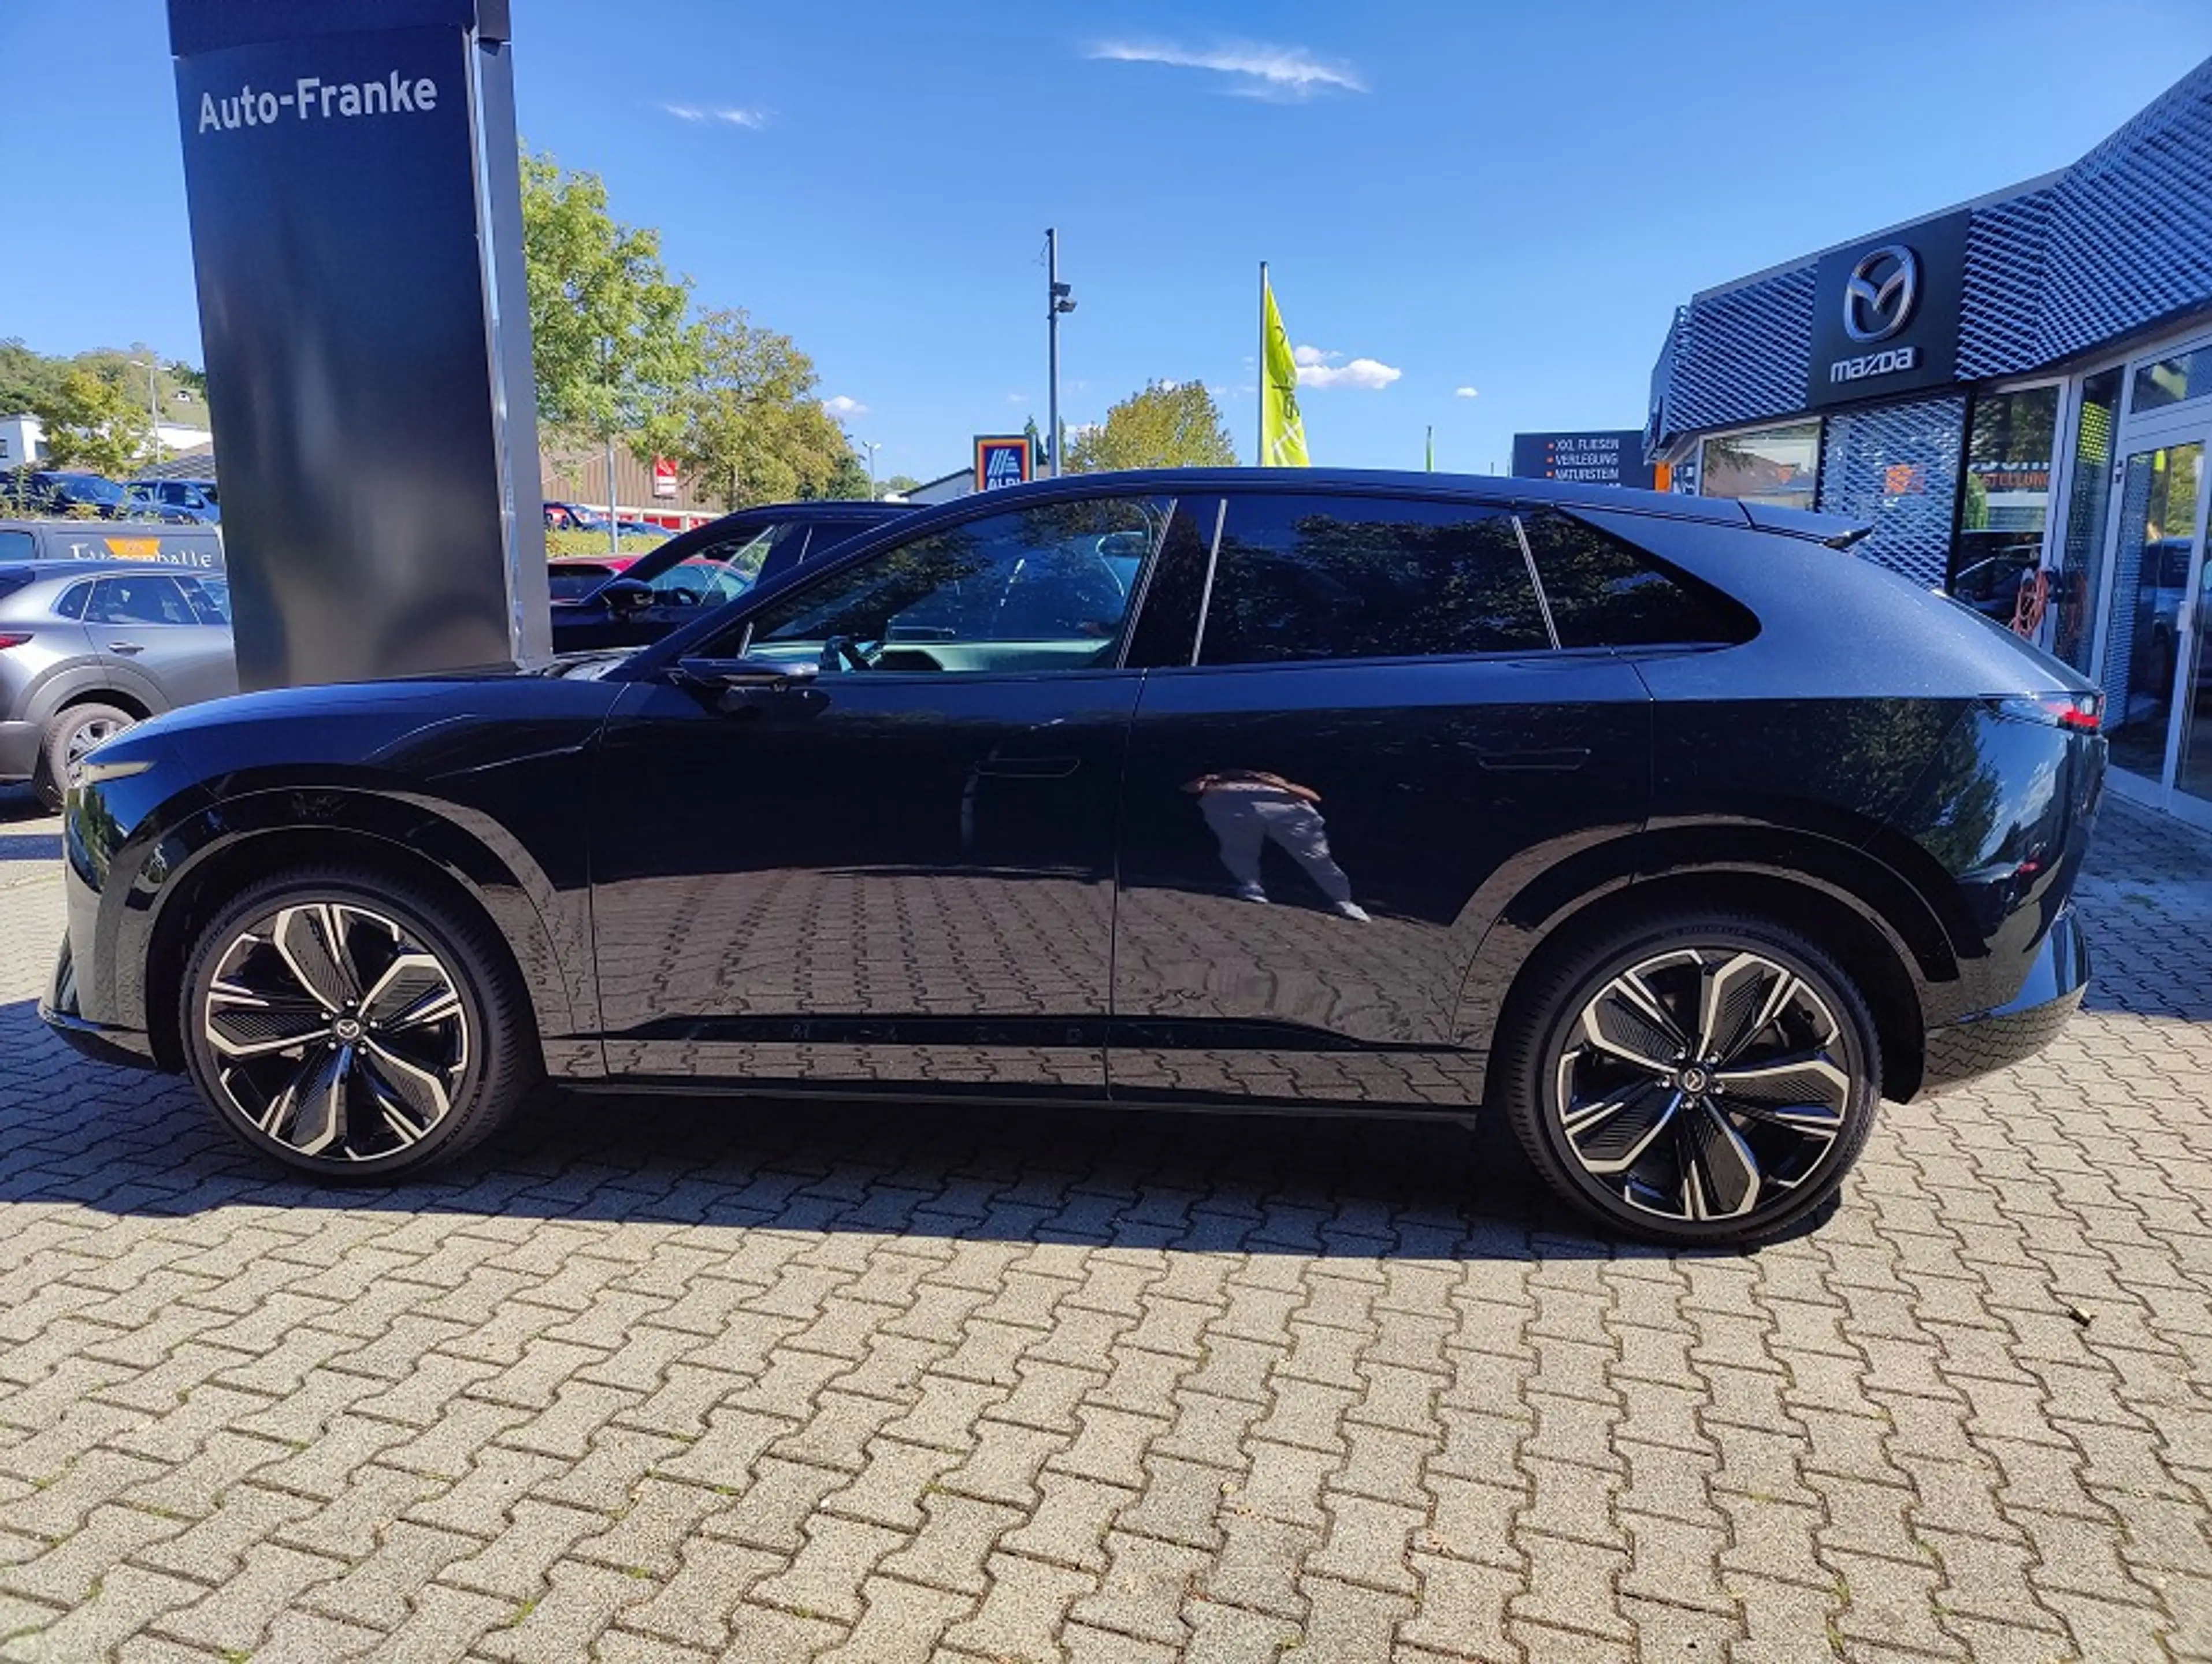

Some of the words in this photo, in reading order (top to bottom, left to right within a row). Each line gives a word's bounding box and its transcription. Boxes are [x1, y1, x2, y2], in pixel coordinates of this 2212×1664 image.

[198, 69, 438, 134] Auto-Franke
[1555, 439, 1574, 451] XXL
[1578, 439, 1619, 450] FLIESEN
[1555, 453, 1618, 466] VERLEGUNG
[1555, 467, 1619, 480] NATURSTEIN
